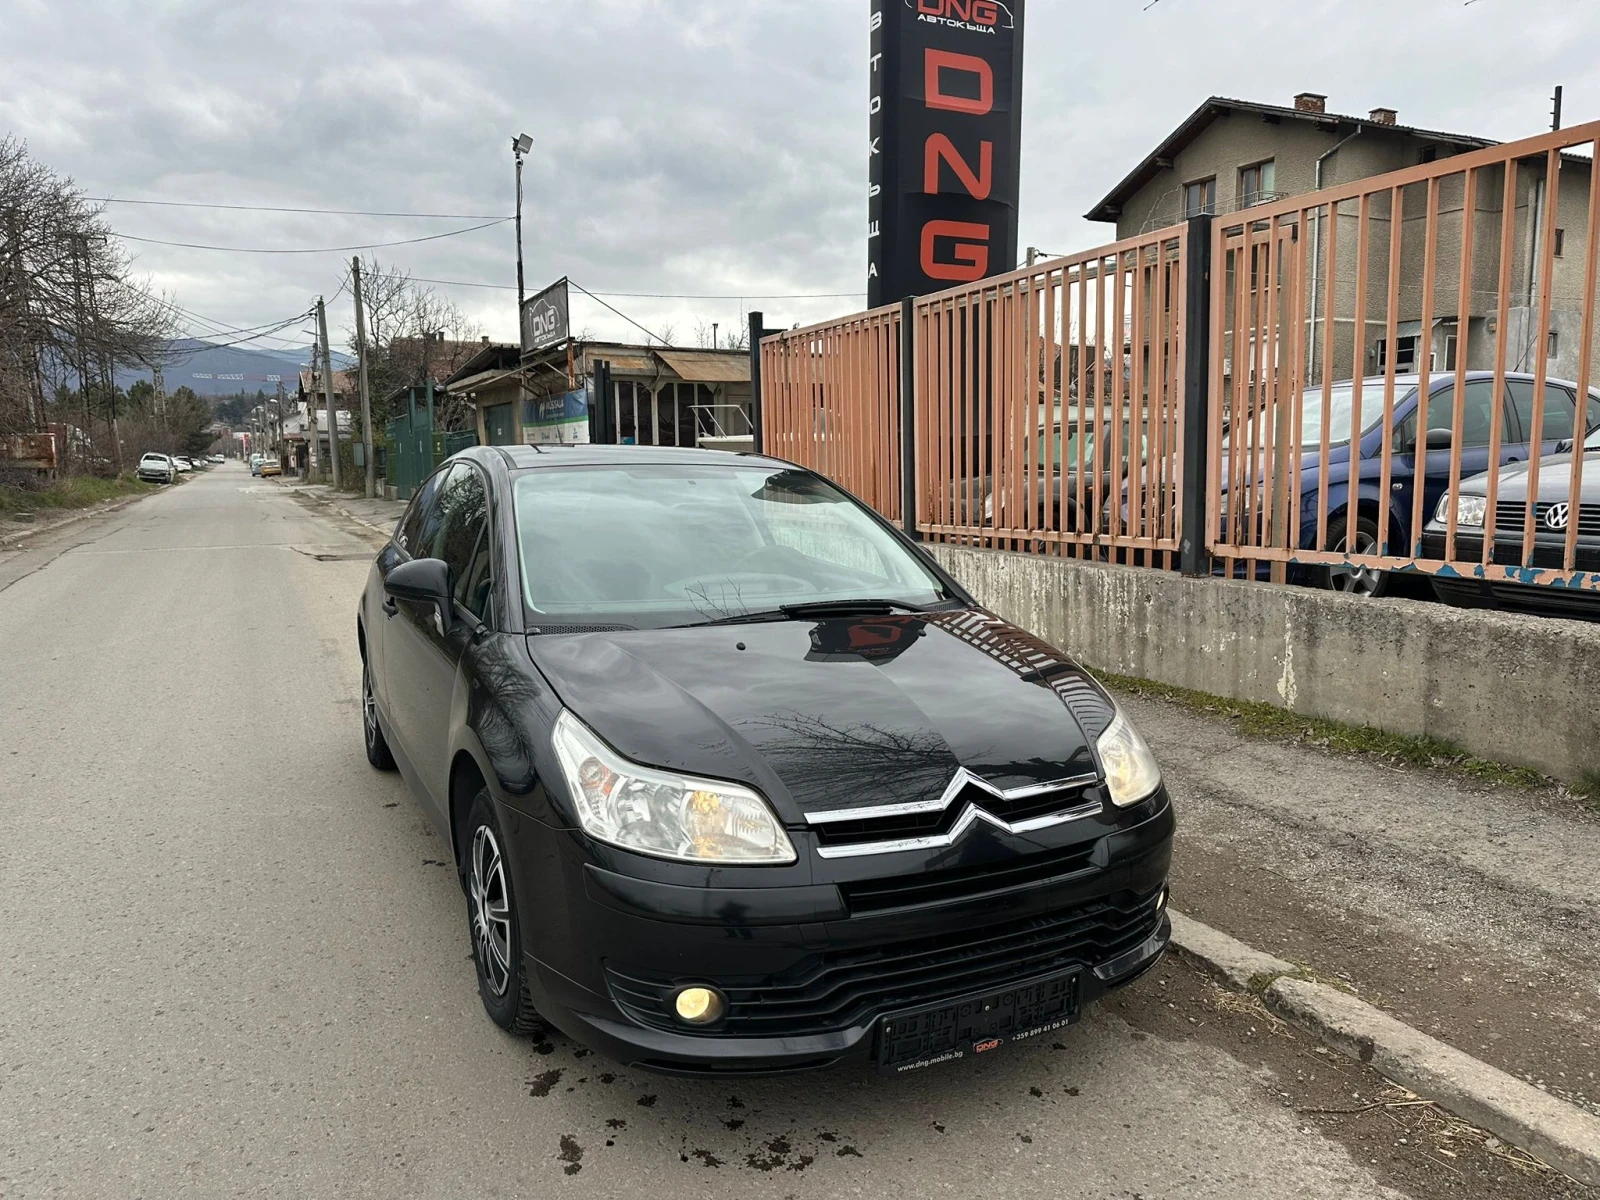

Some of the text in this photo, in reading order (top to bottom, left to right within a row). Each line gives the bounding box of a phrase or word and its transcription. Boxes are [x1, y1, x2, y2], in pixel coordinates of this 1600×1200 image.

[918, 0, 998, 25] DNG
[532, 308, 556, 338] DNG
[1012, 1031, 1029, 1041] +359
[1029, 1027, 1042, 1037] 899
[897, 1050, 964, 1072] www.dng.mobile.bg
